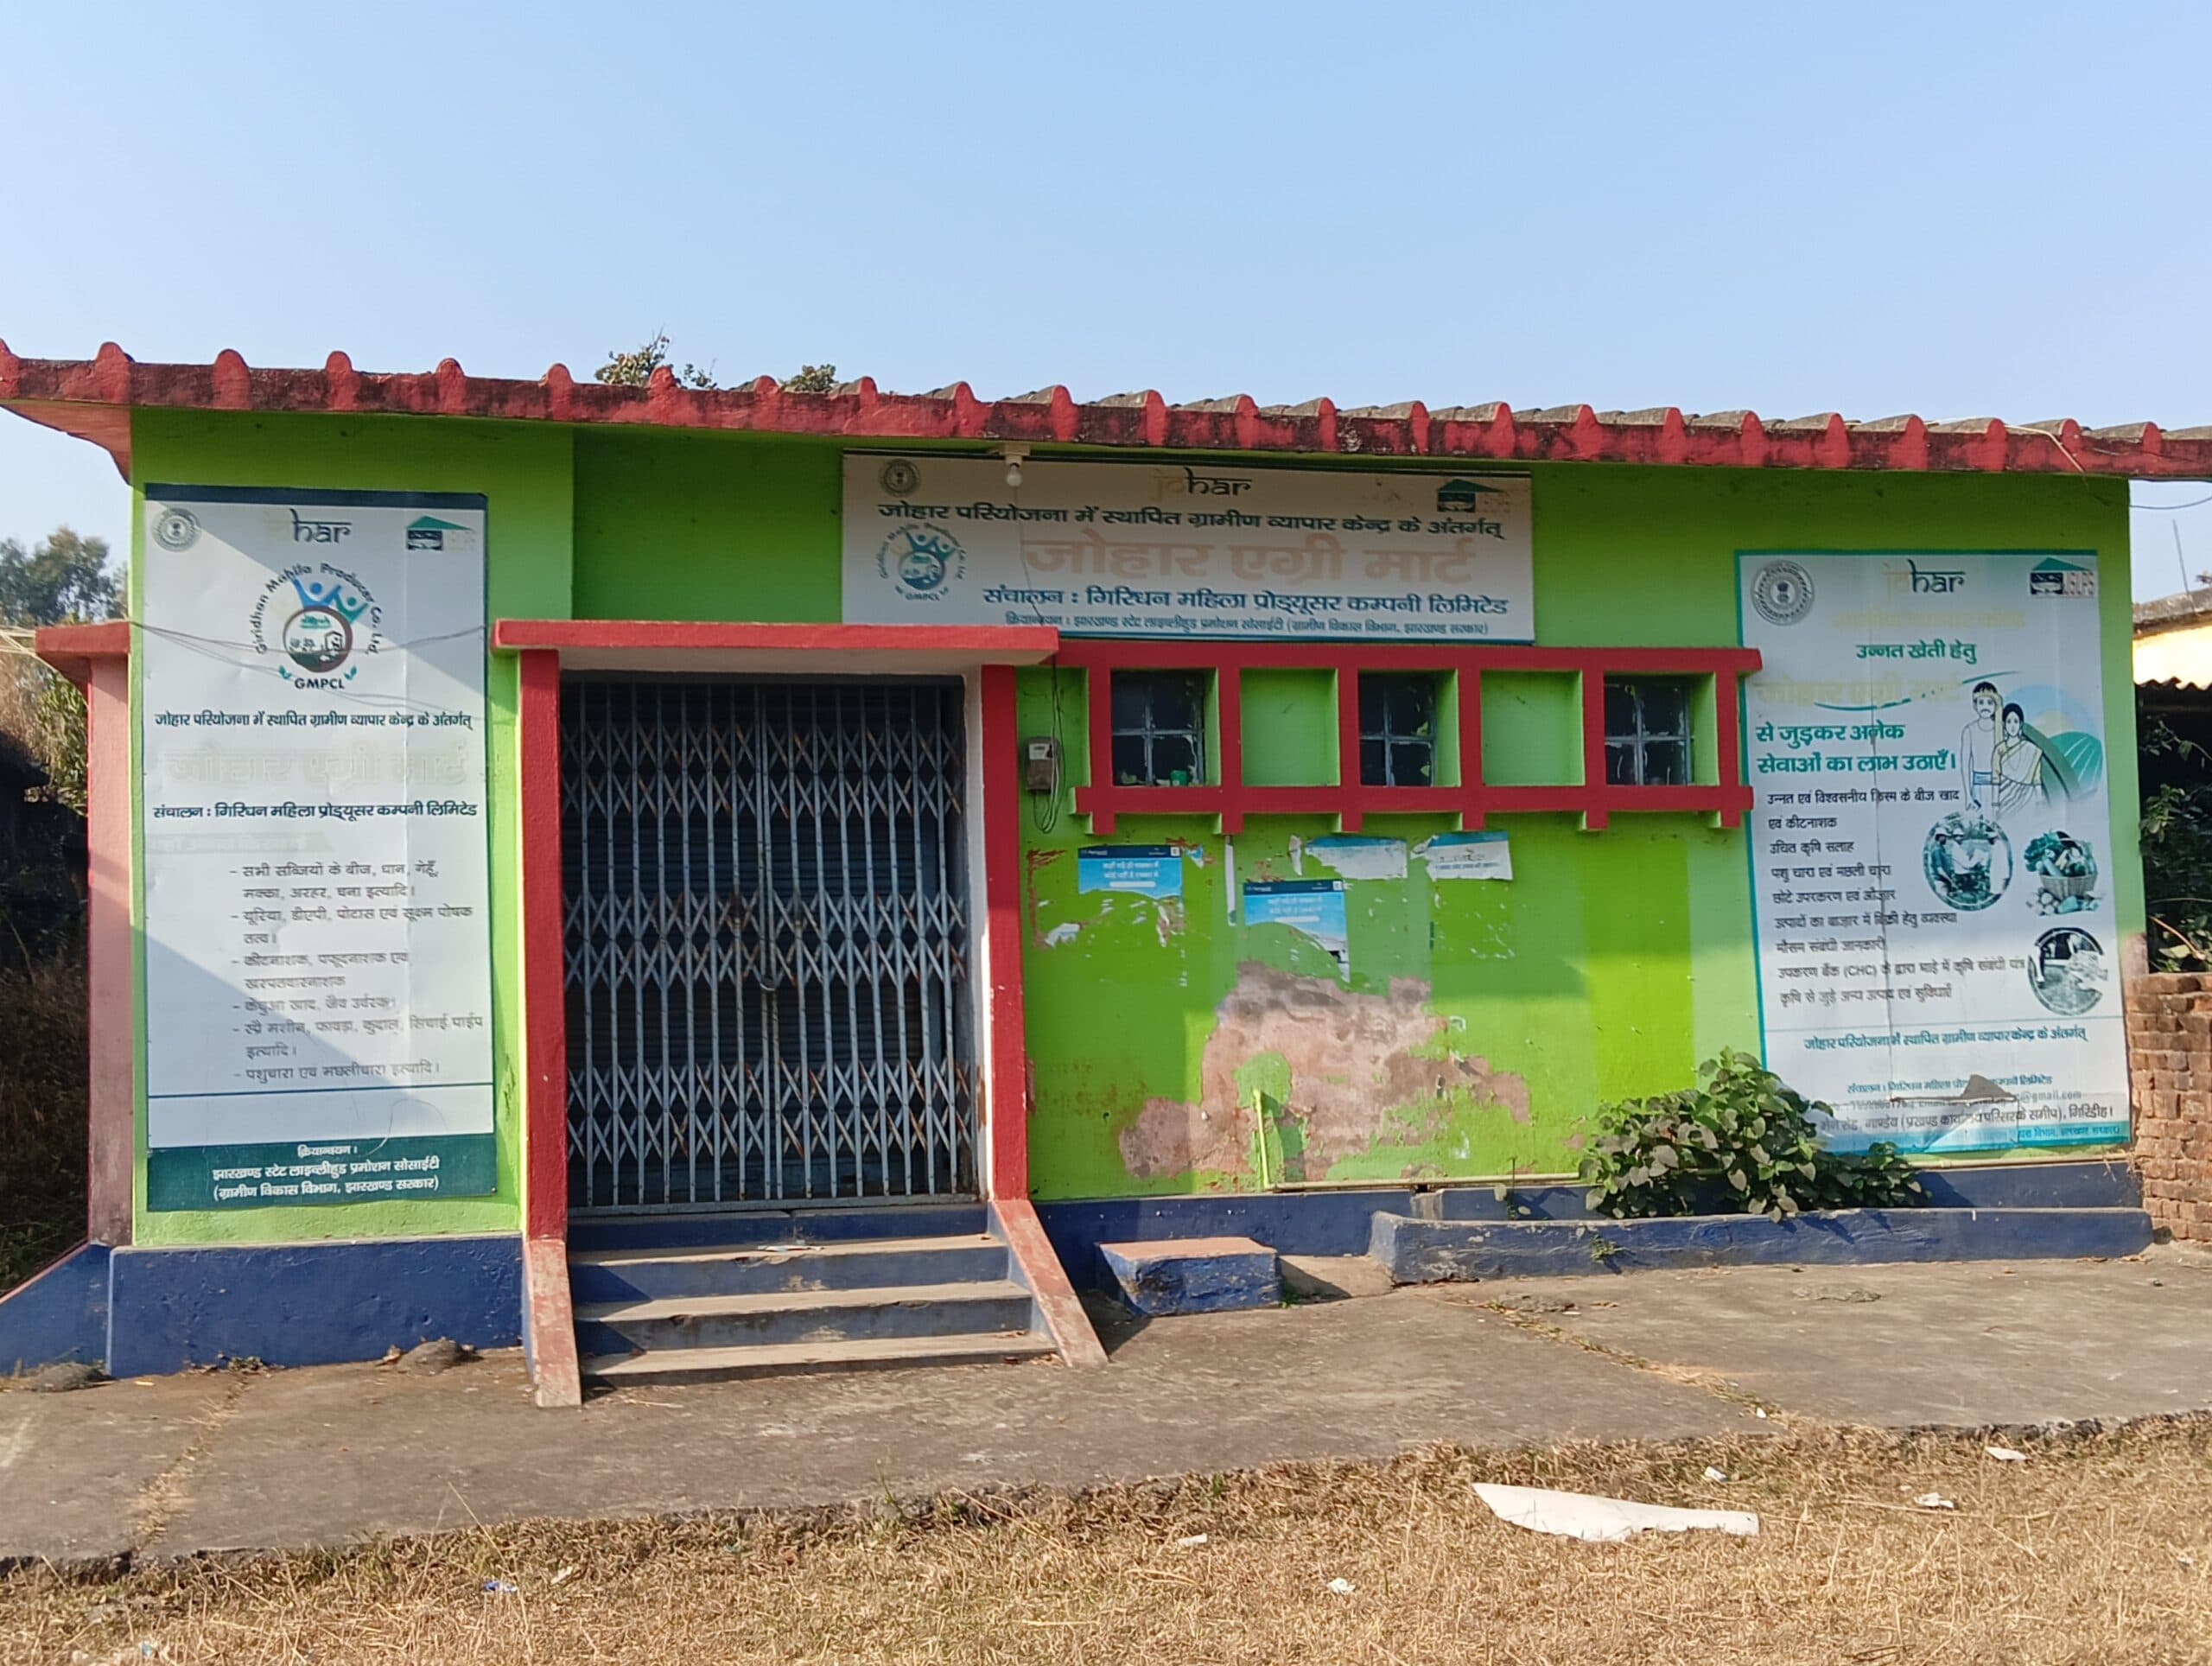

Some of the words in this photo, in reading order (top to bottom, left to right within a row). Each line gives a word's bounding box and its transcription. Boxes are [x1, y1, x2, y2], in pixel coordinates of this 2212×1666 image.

[878, 500, 950, 518] जोहार
[957, 501, 1067, 522] परियोजना
[1076, 506, 1099, 523] में
[1103, 507, 1180, 525] स्थापित
[1188, 510, 1260, 527] ग्रामीण
[1268, 517, 1337, 530] व्यापार
[1343, 517, 1390, 533] केन्द्र
[1399, 518, 1421, 531] के
[1428, 518, 1506, 539] अंतर्गत्
[1021, 528, 1214, 579] जोहार
[1228, 533, 1346, 586] एग्री
[1363, 538, 1477, 582] मार्ट
[265, 563, 312, 593] Mahila
[982, 584, 1063, 604] संचालन
[1087, 585, 1170, 607] गिरिधन
[1178, 588, 1246, 608] महिला
[1254, 591, 1342, 616] प्रोड्यूसर
[1347, 595, 1421, 613] कम्पनी
[1428, 595, 1510, 614] लिमिटेड
[1856, 643, 1904, 659] उन्नत
[1908, 640, 1946, 658] खेती
[1949, 640, 1977, 664] हेतु
[295, 679, 345, 689] GMPCL
[156, 712, 191, 728] जोहार
[194, 711, 250, 727] परियोजना
[252, 712, 264, 726] में
[267, 711, 307, 726] स्थापित
[310, 711, 347, 728] ग्रामीण
[351, 715, 385, 726] व्यापार
[388, 713, 414, 728] केन्द्र
[417, 712, 429, 726] के
[1756, 722, 1774, 742] से
[1778, 725, 1846, 749] जुड़कर
[1849, 720, 1905, 741] अनेक
[1757, 752, 1822, 774] सेवाओं
[1828, 756, 1853, 772] का
[1857, 755, 1897, 771] लाभ
[1768, 794, 1794, 805] उन्नत
[1798, 790, 1811, 804] एवं
[1815, 789, 1867, 804] विश्वसनीय
[1900, 788, 1911, 801] के
[1915, 788, 1934, 801] बीज
[1940, 790, 1960, 801] खाद
[154, 804, 203, 818] संचालन
[270, 802, 315, 817] महिला
[377, 803, 423, 817] कम्पनी
[427, 802, 477, 817] लिमिटेड
[1769, 815, 1782, 830] एवं
[1785, 815, 1837, 829] कीटनाशक
[1770, 840, 1796, 854] उचित
[1801, 840, 1821, 856] कृषि
[1826, 842, 1854, 852] सलाह
[242, 862, 270, 877] सभी
[328, 862, 342, 876] के
[1771, 868, 1790, 882] पशु
[1793, 867, 1815, 878] चारा
[1819, 864, 1833, 877] एवं
[1844, 963, 1877, 977] (CHC)
[1805, 1037, 1836, 1050] जोहार
[1838, 1033, 1890, 1049] परियोजना
[1904, 1030, 1939, 1046] स्थापित
[1942, 1029, 1976, 1046] ग्रामीण
[1979, 1030, 2009, 1042] व्यापार
[2037, 1027, 2048, 1040] के
[213, 1167, 263, 1180] झारखण्ड
[265, 1163, 288, 1178] स्टेट
[349, 1158, 391, 1176] प्रमोशन
[213, 1184, 257, 1202] (ग्रामीण
[260, 1181, 299, 1198] विकास
[345, 1180, 393, 1195] झारखण्ड
